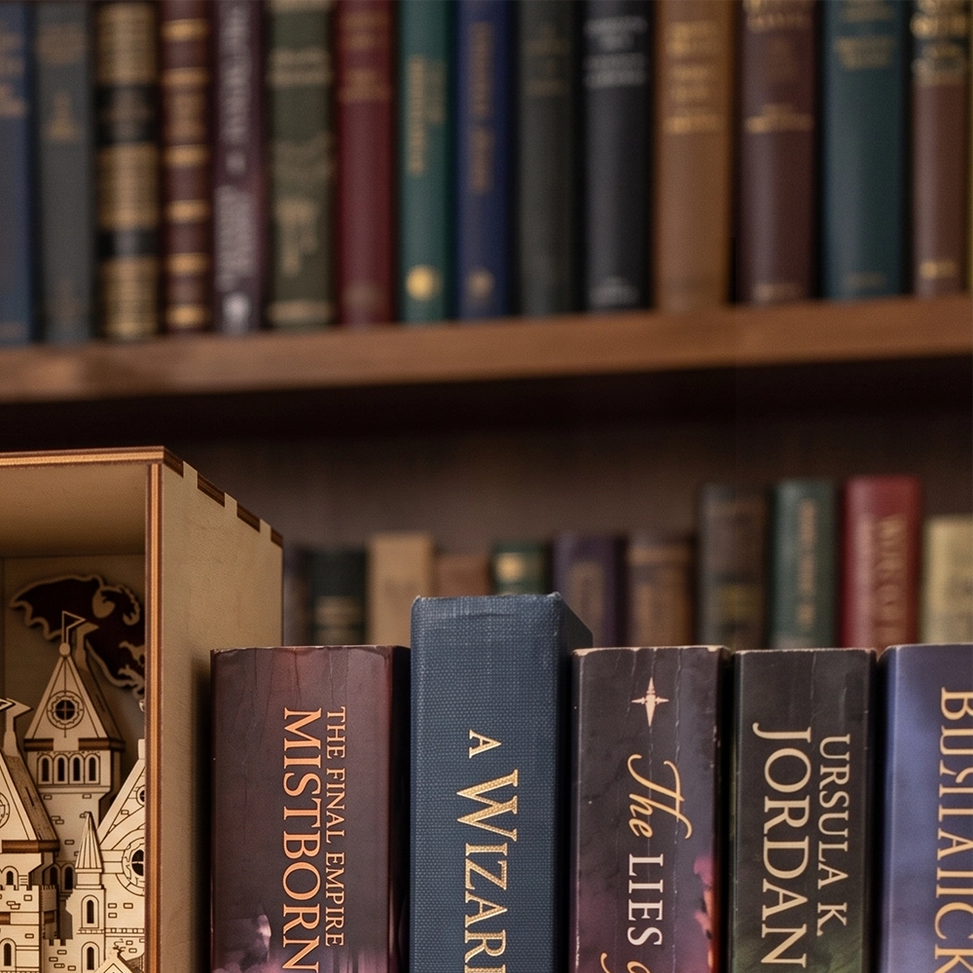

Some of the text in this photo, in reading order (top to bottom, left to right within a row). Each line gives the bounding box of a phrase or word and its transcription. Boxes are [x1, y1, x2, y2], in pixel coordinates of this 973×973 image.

[469, 729, 502, 758] A
[627, 754, 692, 839] The
[817, 734, 850, 890] URSULA
[281, 706, 322, 973] MISTBORN
[325, 706, 346, 947] THE FINAL EMPIRE
[627, 853, 665, 946] LIES
[752, 722, 812, 968] JORDAN
